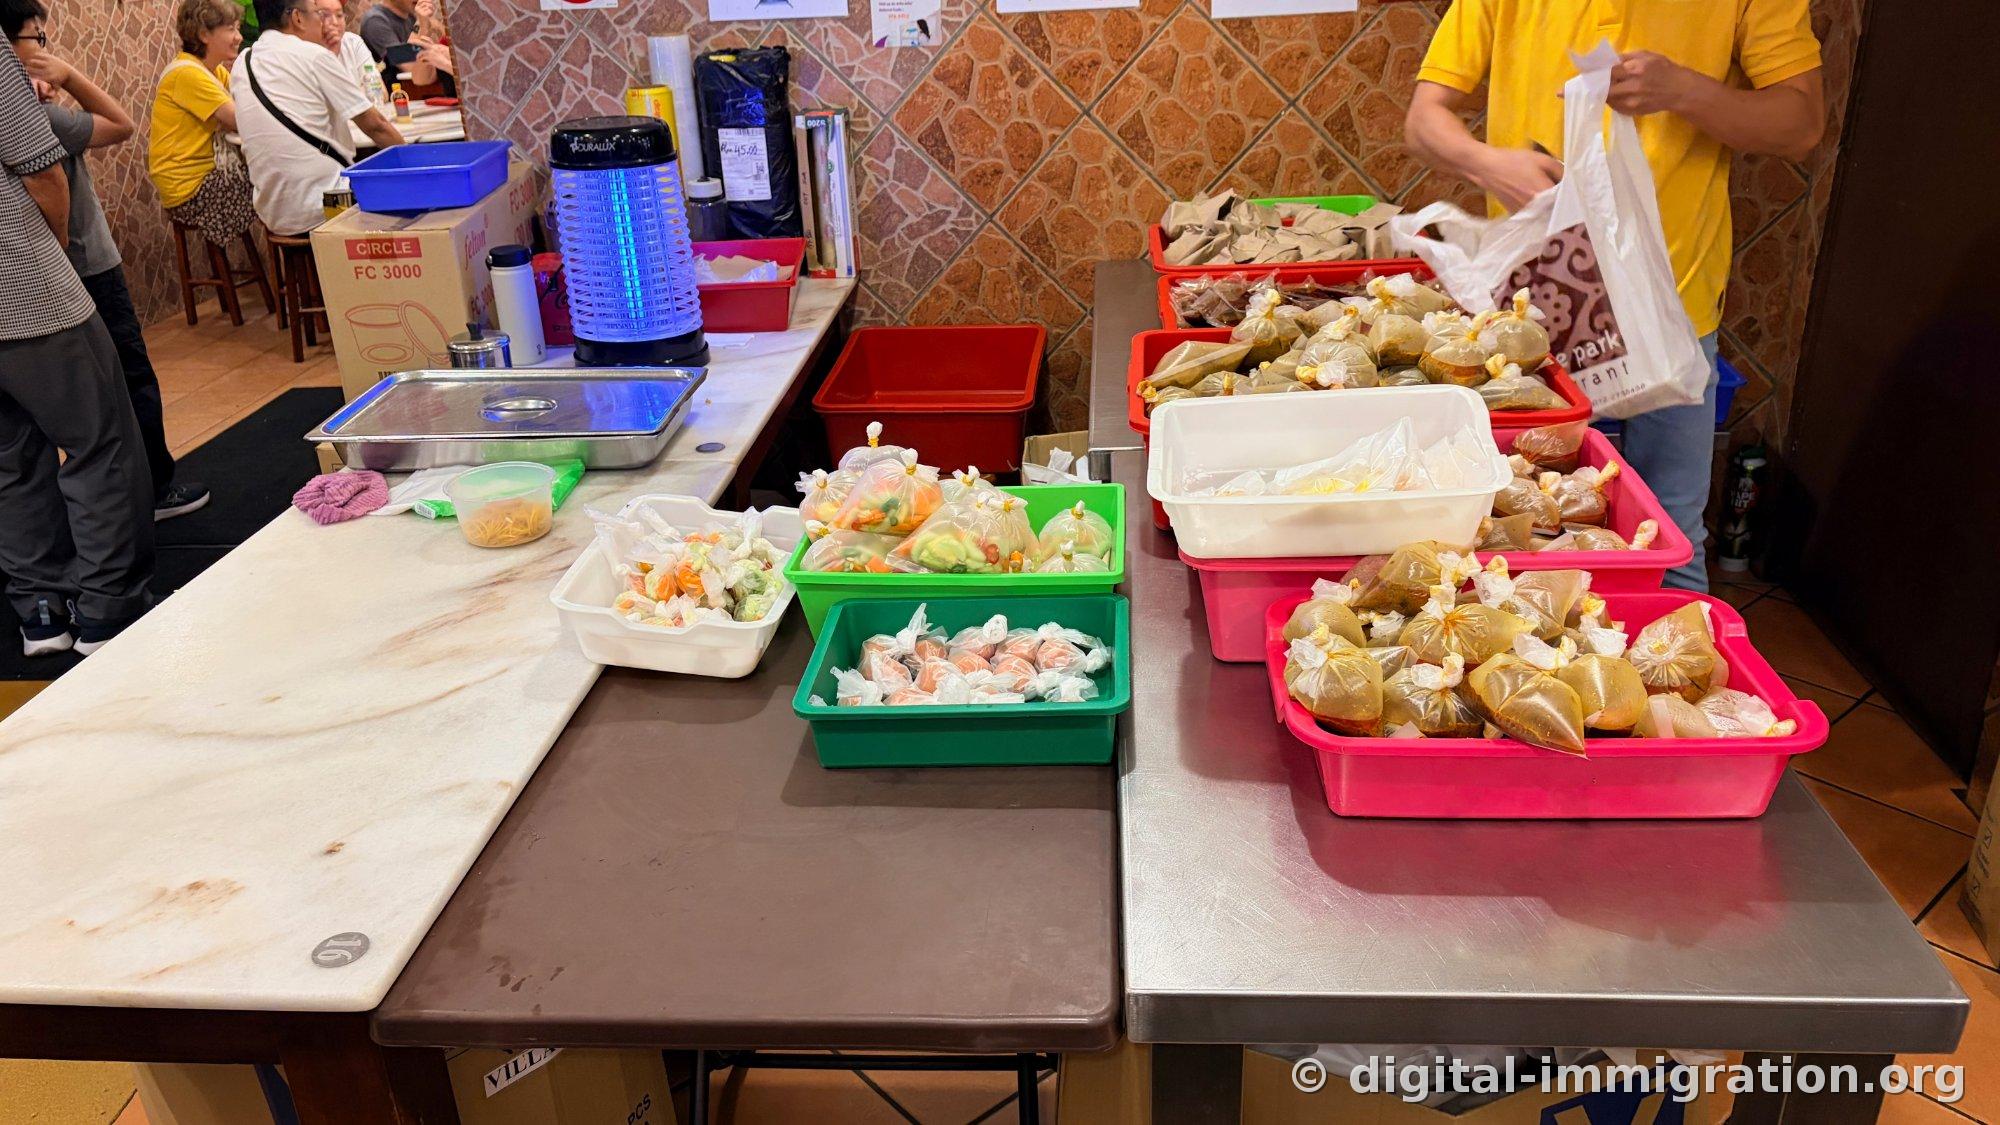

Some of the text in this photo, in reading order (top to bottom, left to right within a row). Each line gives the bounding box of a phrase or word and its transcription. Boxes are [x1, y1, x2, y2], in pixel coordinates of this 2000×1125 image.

[356, 241, 412, 255] CIRCLE
[354, 264, 422, 280] FC 3000
[1572, 329, 1621, 369] park
